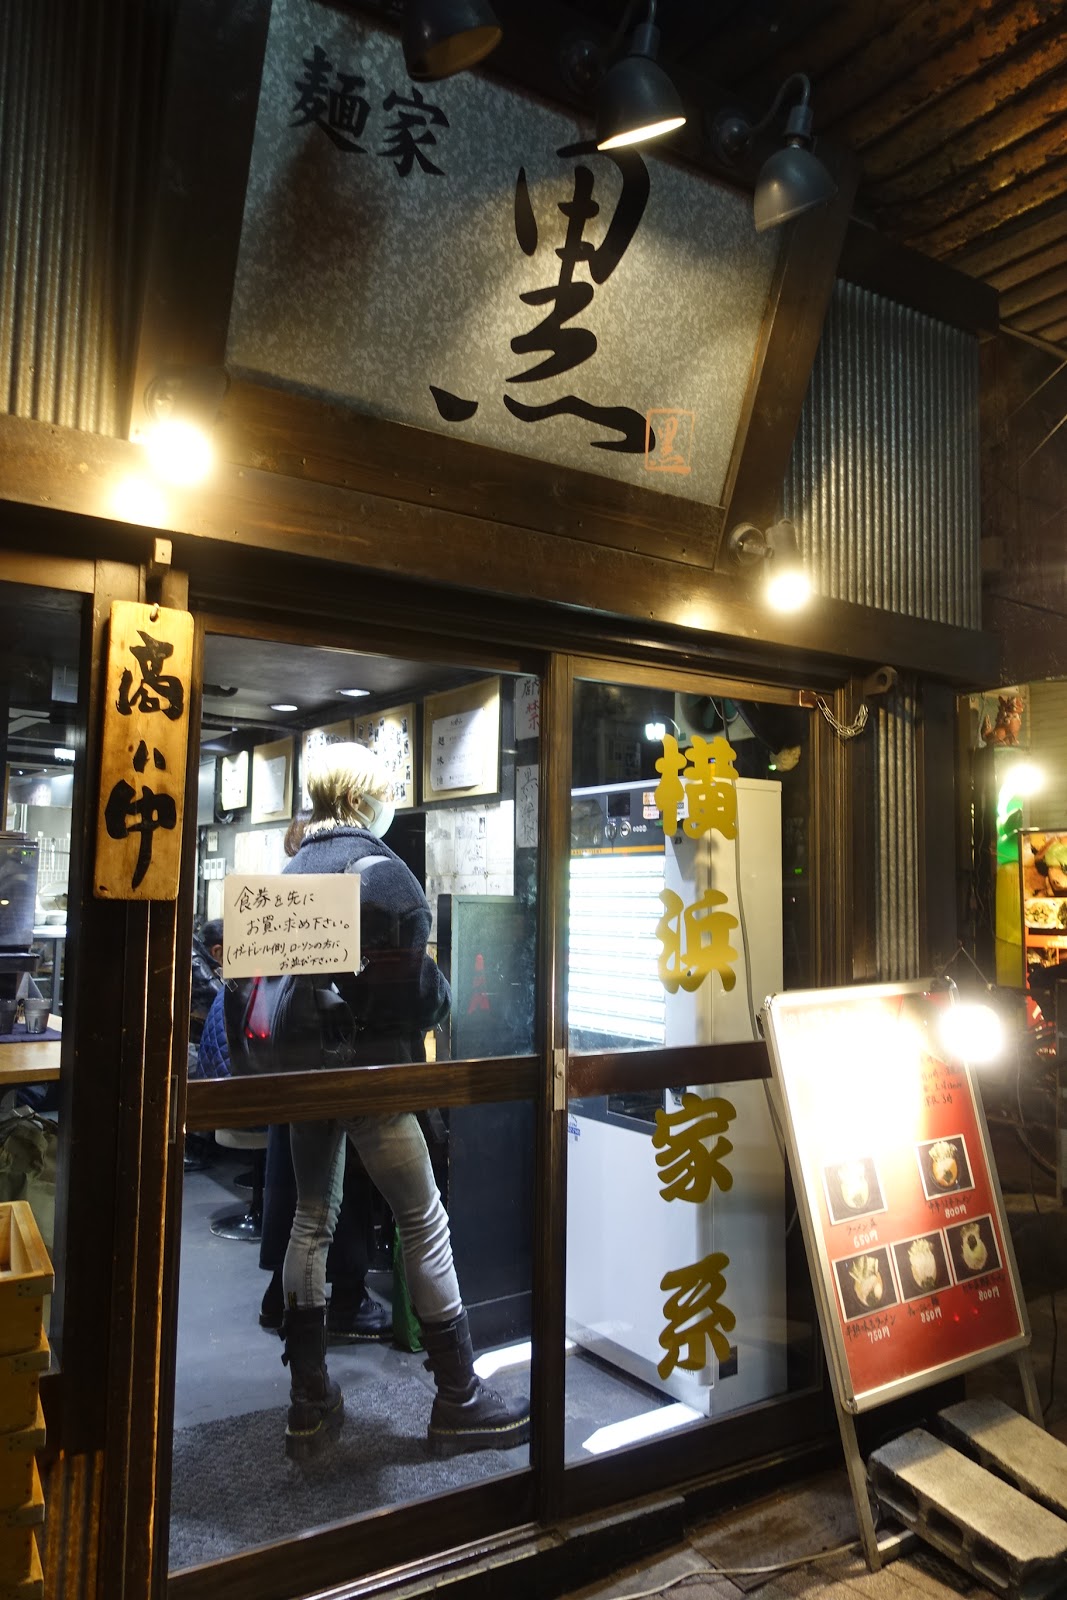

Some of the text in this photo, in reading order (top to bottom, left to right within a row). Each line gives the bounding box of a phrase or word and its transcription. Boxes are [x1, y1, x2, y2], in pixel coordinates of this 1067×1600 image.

[234, 886, 314, 913] 食券を先に
[247, 913, 350, 936] お買い求め下さい。
[652, 733, 739, 1380] 横浜家系
[944, 1203, 967, 1219] 800円
[853, 1229, 879, 1249] 650円
[978, 1285, 1001, 1301] 800円
